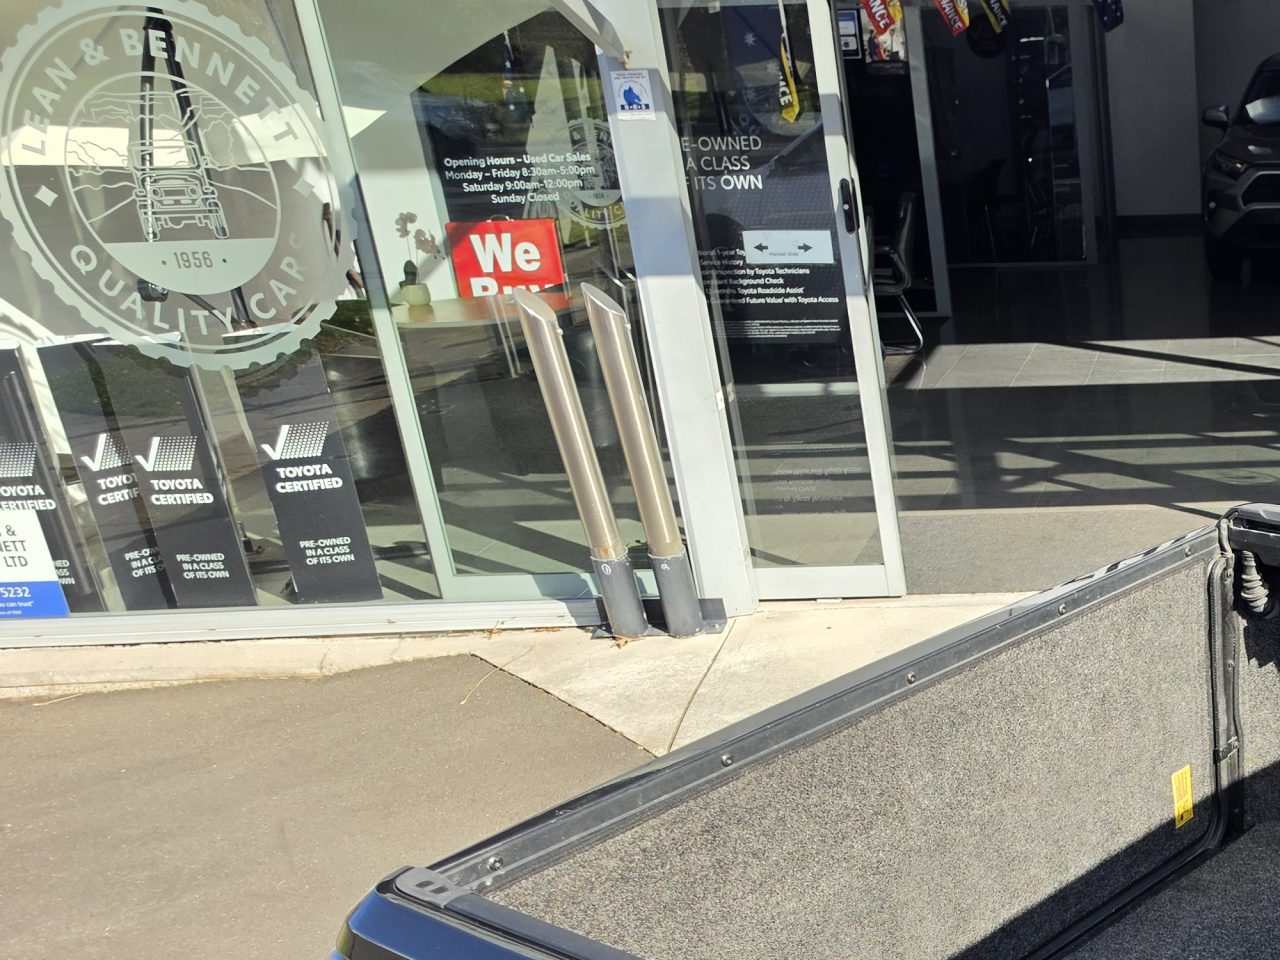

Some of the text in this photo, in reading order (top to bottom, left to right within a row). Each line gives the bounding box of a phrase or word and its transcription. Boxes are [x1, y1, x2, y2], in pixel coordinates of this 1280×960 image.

[79, 37, 110, 66] &
[119, 28, 300, 144] BENNETT
[681, 135, 762, 152] E-OWNED
[444, 156, 486, 168] Opening
[486, 156, 515, 166] Hours
[522, 154, 547, 164] Used
[549, 153, 564, 163] Car
[566, 152, 591, 162] Sales
[686, 155, 751, 171] A CLASS
[445, 168, 483, 180] Monday
[491, 168, 520, 179] Friday
[522, 165, 595, 177] 8:30am-5:00pm
[462, 179, 583, 193] Saturday 9:00am-12:00pm
[694, 175, 717, 190] ITS
[720, 174, 763, 190] OWN
[491, 191, 560, 205] Sunday Closed
[469, 232, 541, 273] We
[173, 251, 213, 270] 1956
[746, 268, 755, 276] by
[755, 268, 775, 276] Toyota
[70, 244, 234, 336] QUALITY
[798, 296, 817, 304] Toyota
[276, 463, 332, 479] TOYOTA
[97, 473, 138, 490] TOYOT
[151, 478, 203, 490] TOYOTA
[276, 477, 343, 493] CERTIFIED
[0, 485, 45, 497] OYOTA
[98, 488, 140, 505] CERTIF
[151, 493, 214, 505] CERTIFIED
[299, 537, 351, 548] PRE-OWNED
[176, 552, 225, 562] PRE-OWNED
[306, 545, 350, 557] IN A CLASS
[4, 555, 28, 567] LTD
[182, 563, 192, 571] IN
[200, 562, 224, 570] CLASS
[306, 553, 355, 566] OF ITS OWN
[132, 569, 145, 578] OF
[183, 570, 230, 579] OF ITS OWN
[0, 586, 31, 598] 5232
